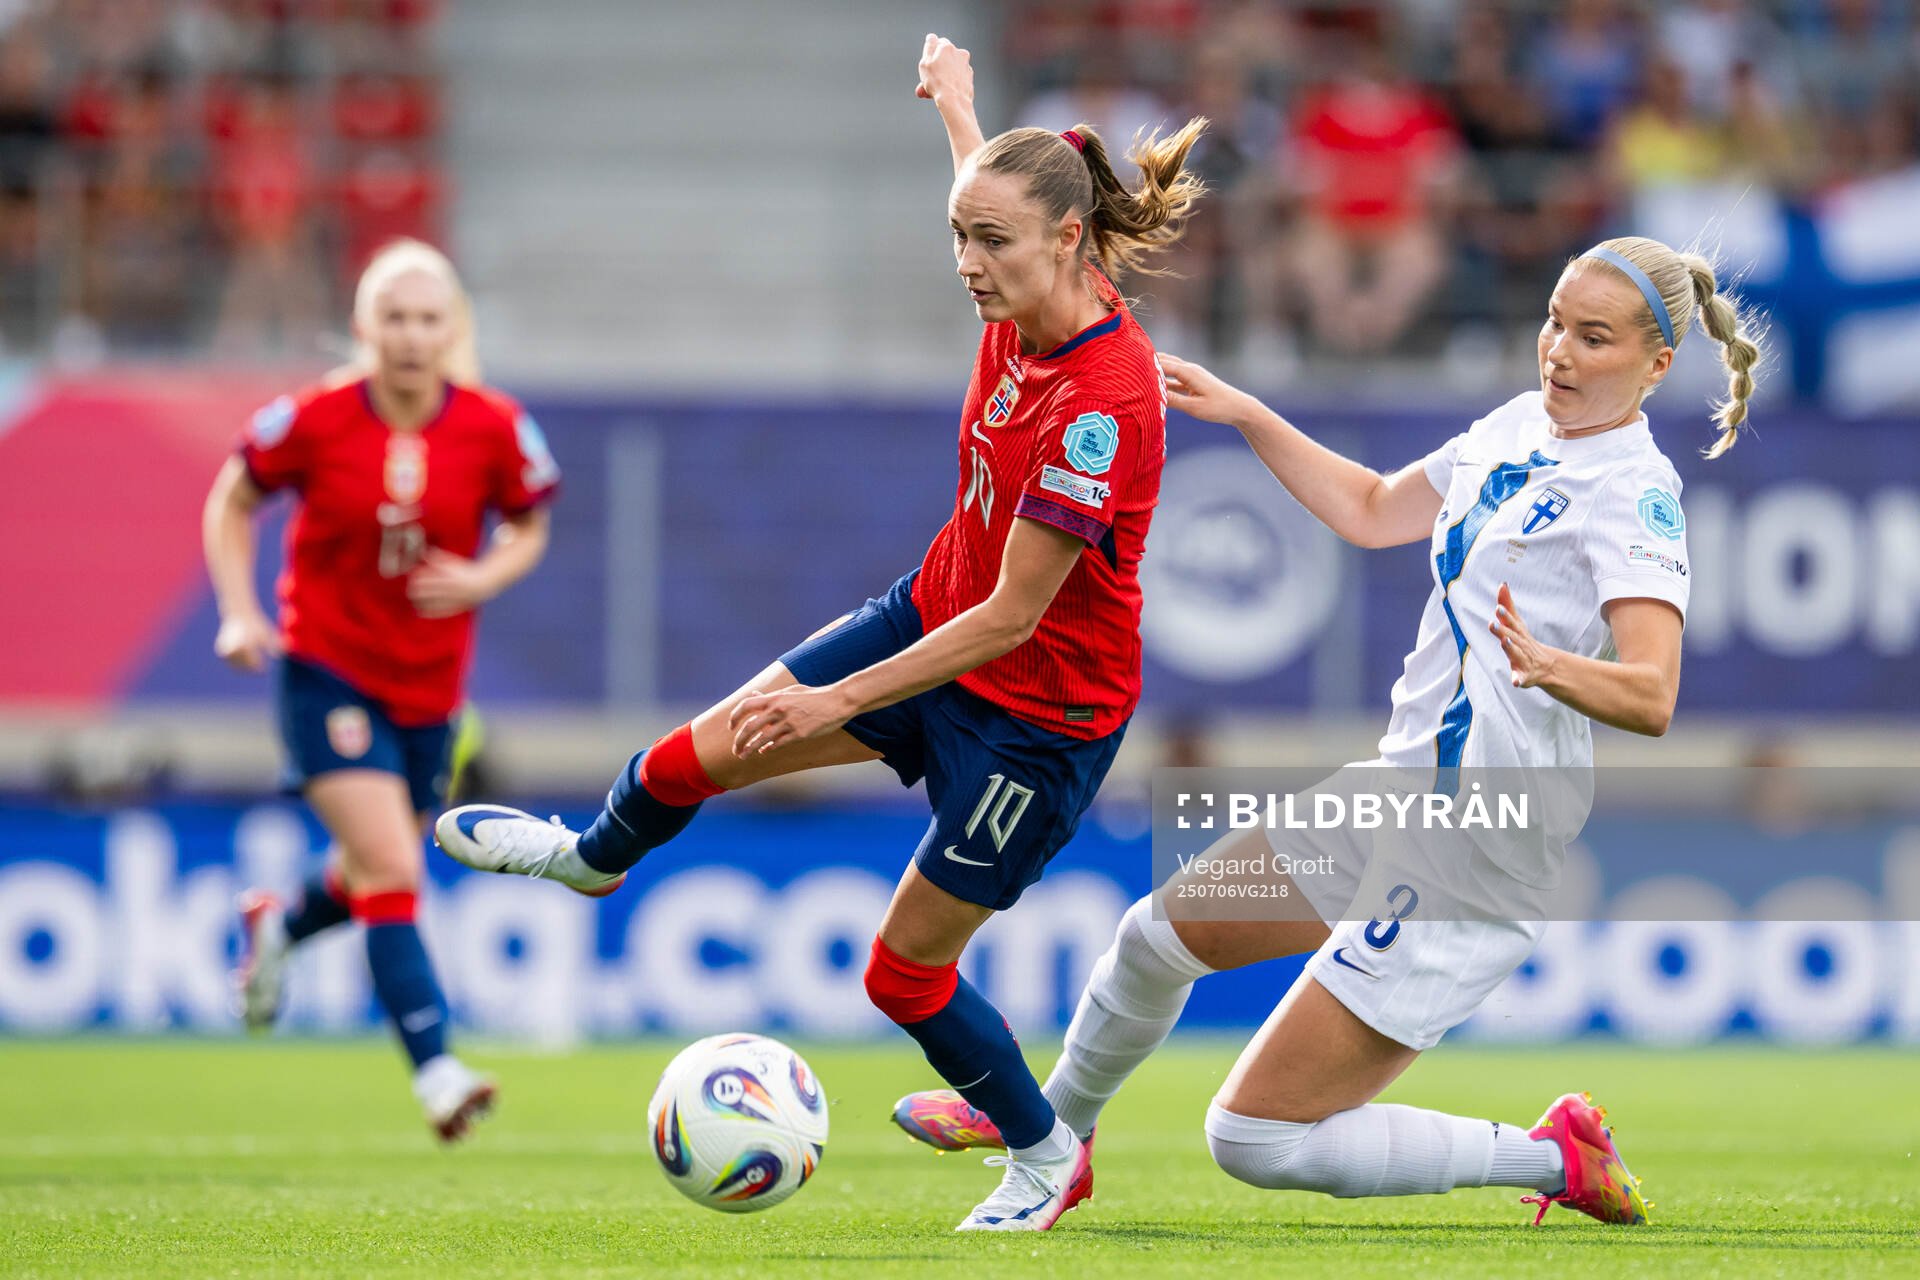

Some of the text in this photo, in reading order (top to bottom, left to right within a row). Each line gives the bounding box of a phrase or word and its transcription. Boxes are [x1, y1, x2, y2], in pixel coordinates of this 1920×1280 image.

[963, 446, 995, 531] 10
[965, 773, 1036, 854] 10
[1363, 883, 1419, 952] 3
